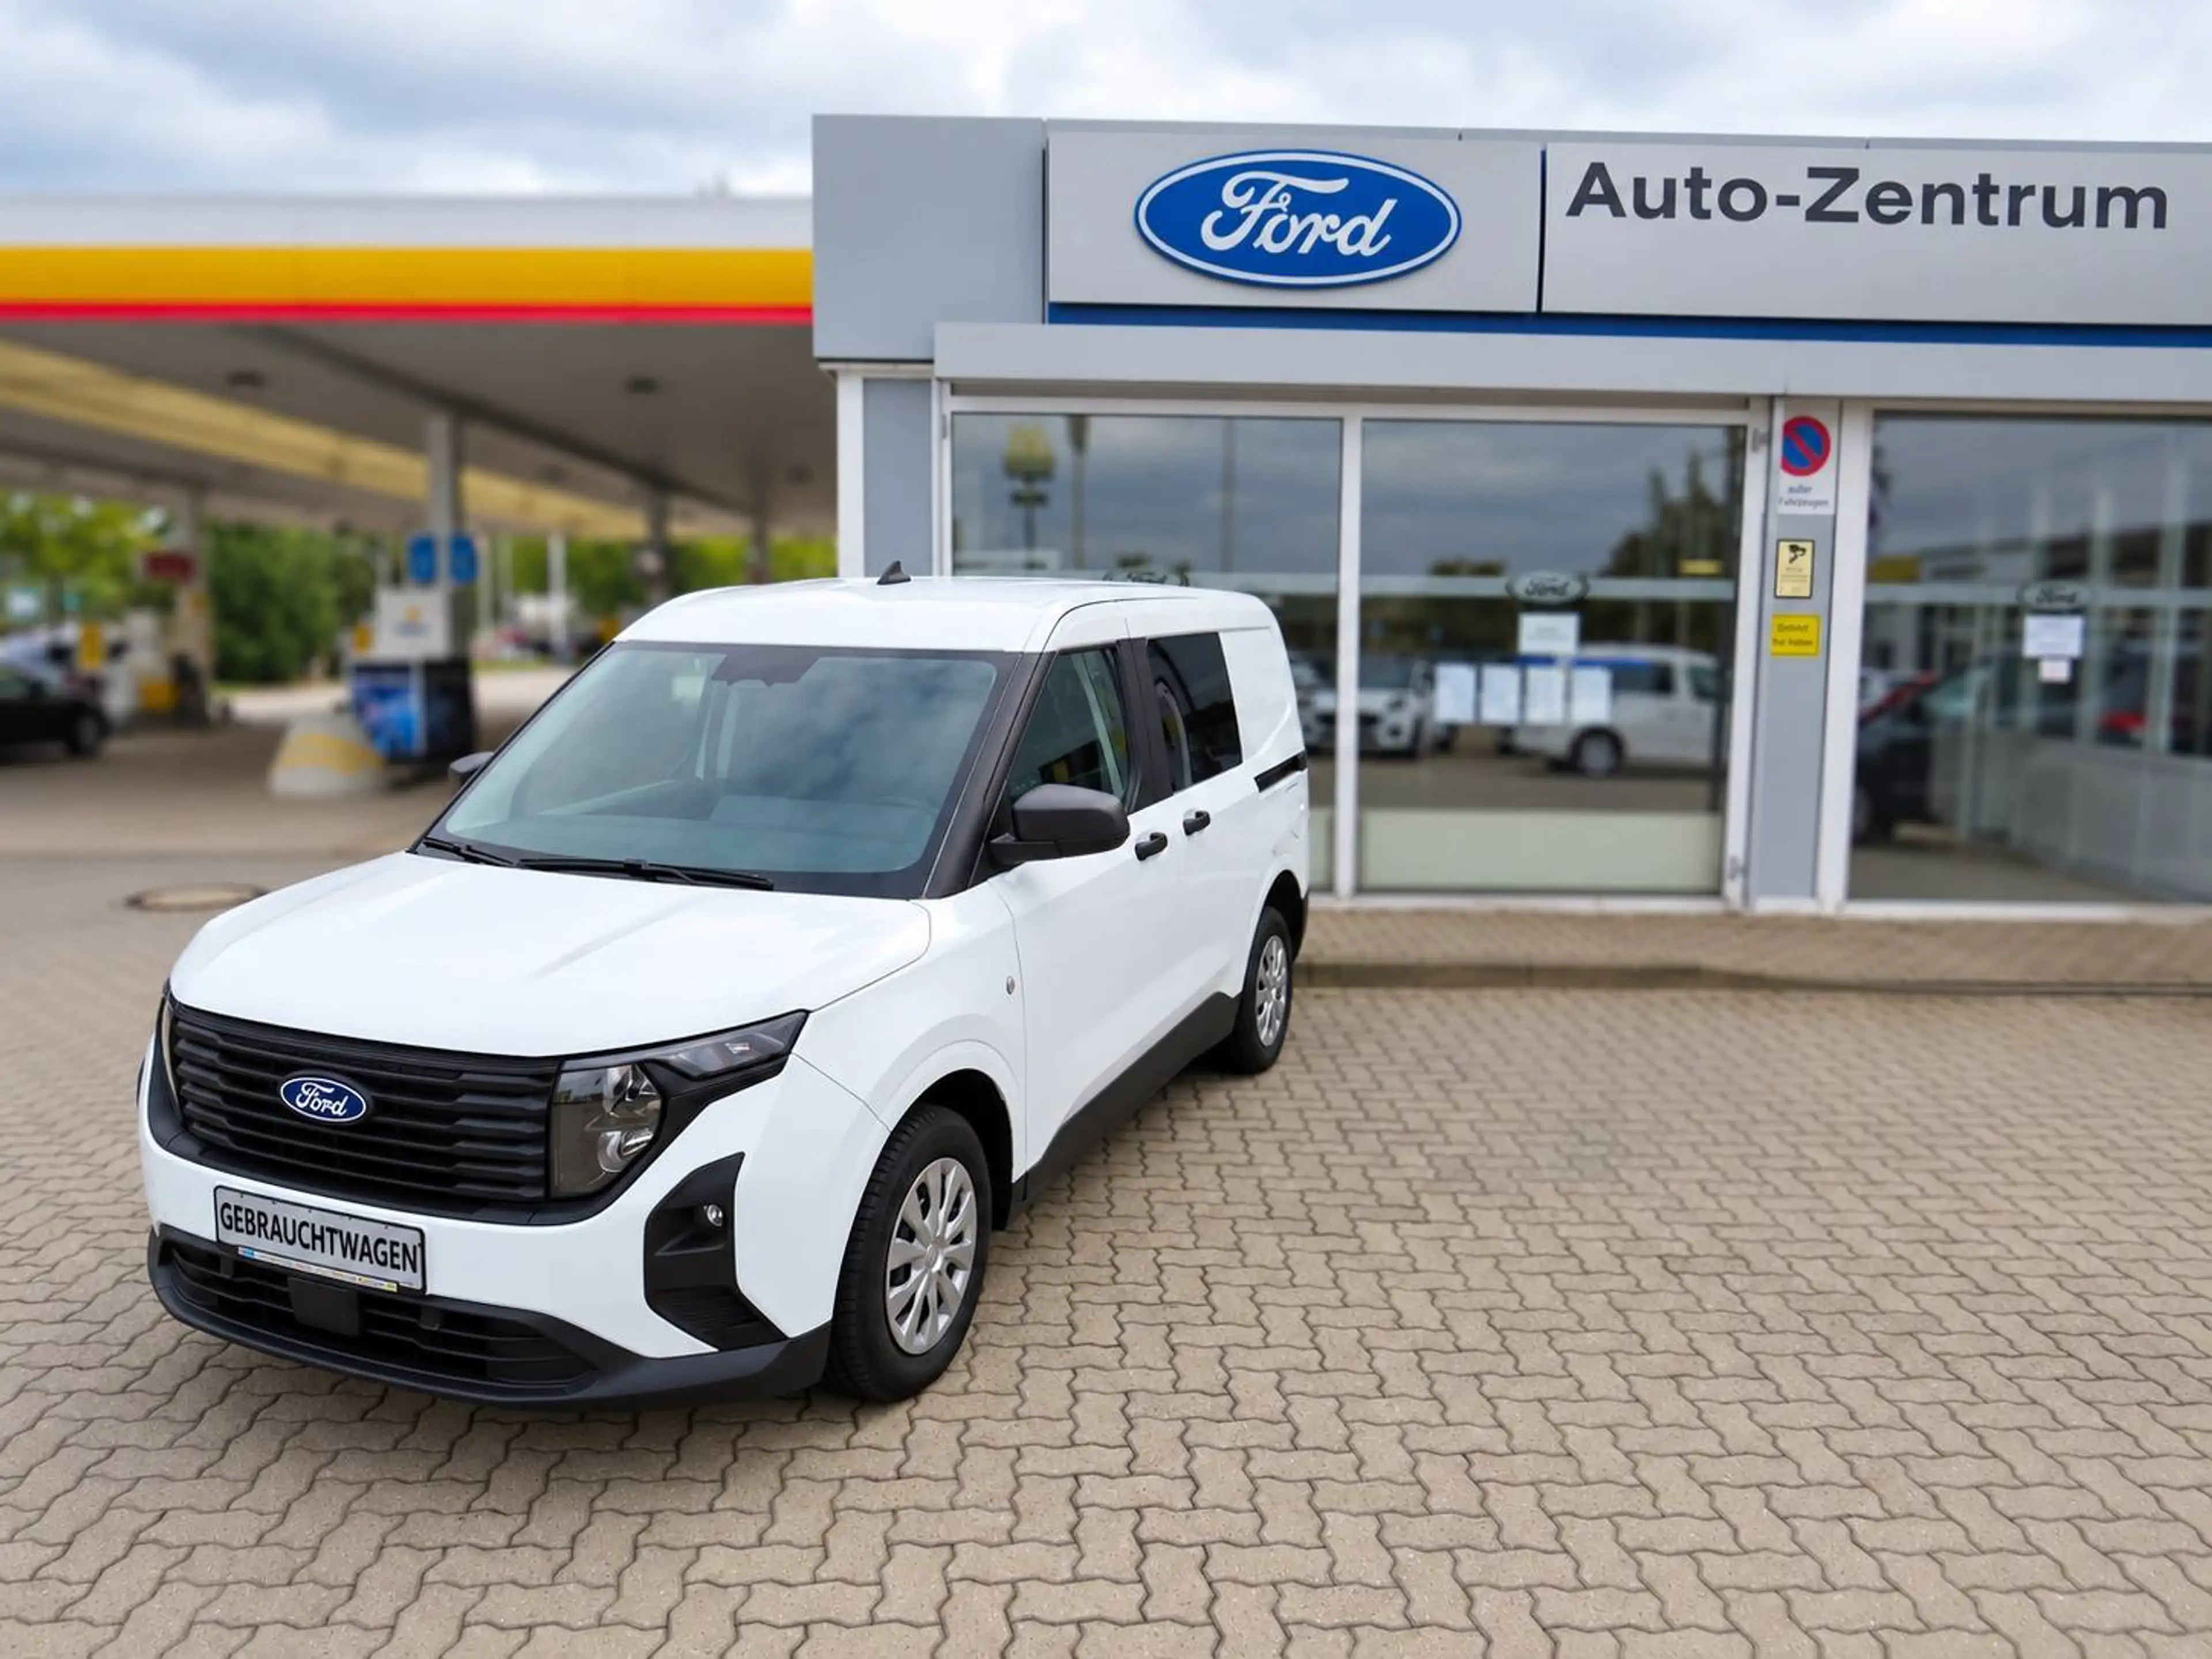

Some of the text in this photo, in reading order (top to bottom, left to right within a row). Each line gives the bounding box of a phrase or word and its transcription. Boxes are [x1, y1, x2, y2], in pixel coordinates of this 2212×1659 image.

[1200, 171, 1397, 257] Ford
[1566, 162, 2168, 230] Auto-Zentrum
[295, 1081, 347, 1116] Ford
[219, 1202, 418, 1273] GEBRAUCHTWAGEN
